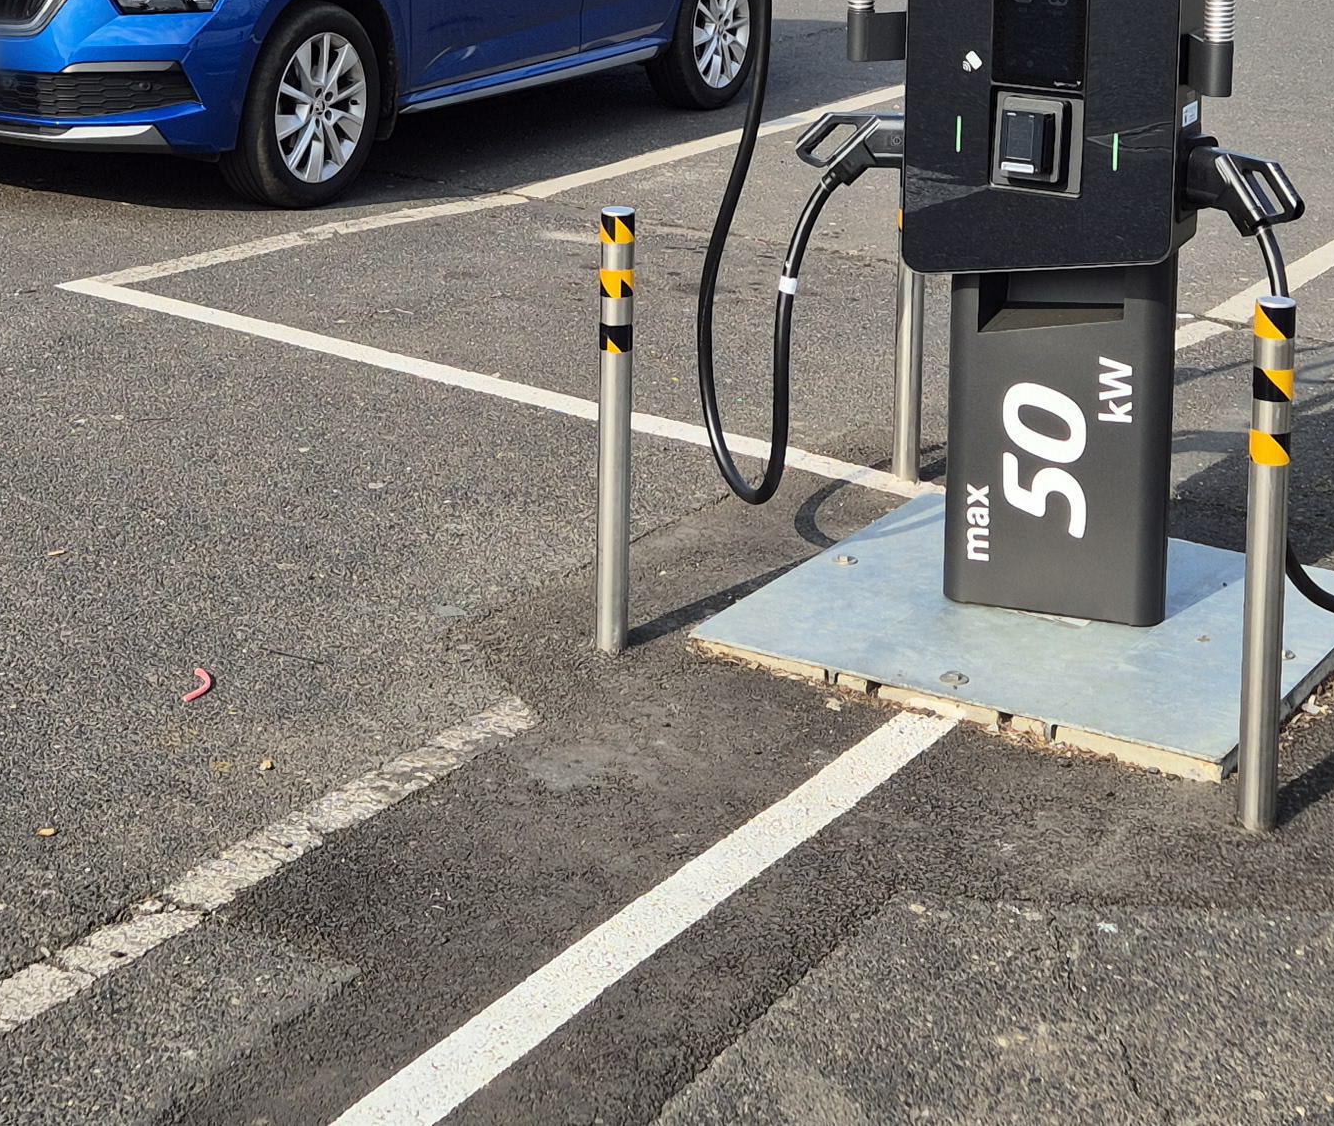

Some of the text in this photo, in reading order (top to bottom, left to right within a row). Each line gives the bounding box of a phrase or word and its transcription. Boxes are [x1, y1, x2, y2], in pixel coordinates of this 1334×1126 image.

[1098, 356, 1133, 424] kW
[1002, 382, 1087, 539] 50
[966, 482, 990, 562] max
